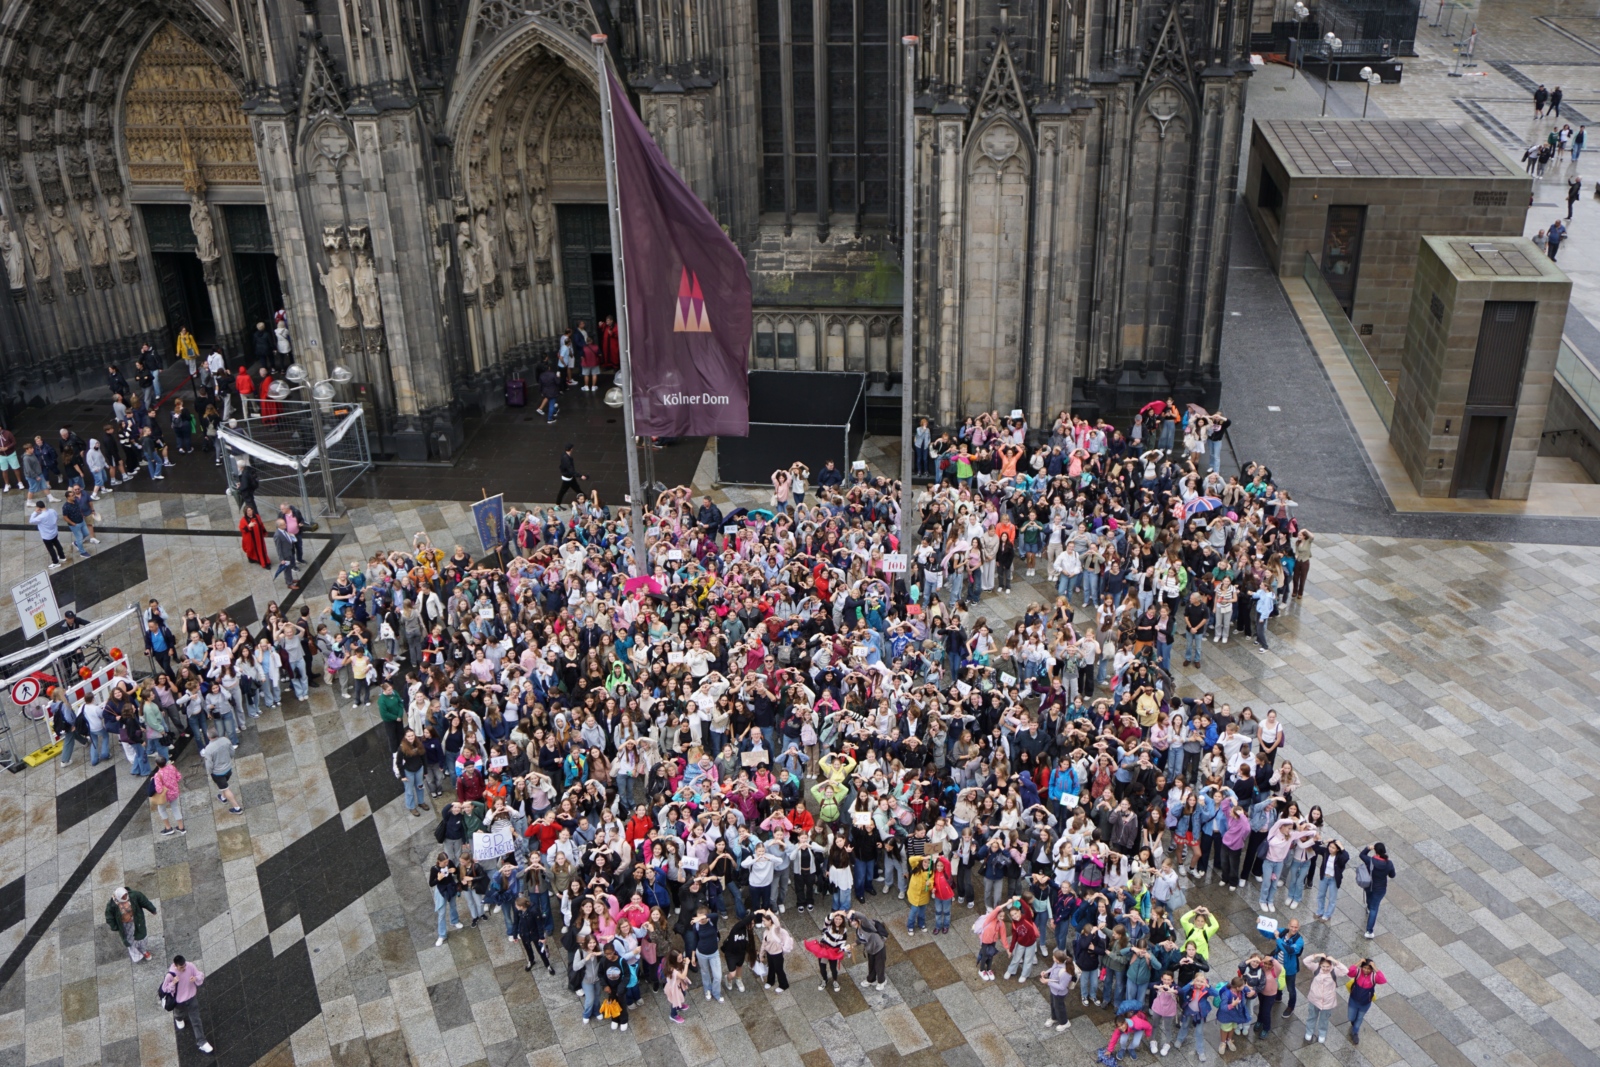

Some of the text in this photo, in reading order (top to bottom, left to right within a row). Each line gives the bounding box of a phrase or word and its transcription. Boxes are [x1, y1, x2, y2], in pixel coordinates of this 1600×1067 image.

[663, 391, 729, 406] Kölner Dom
[888, 561, 906, 570] 10b
